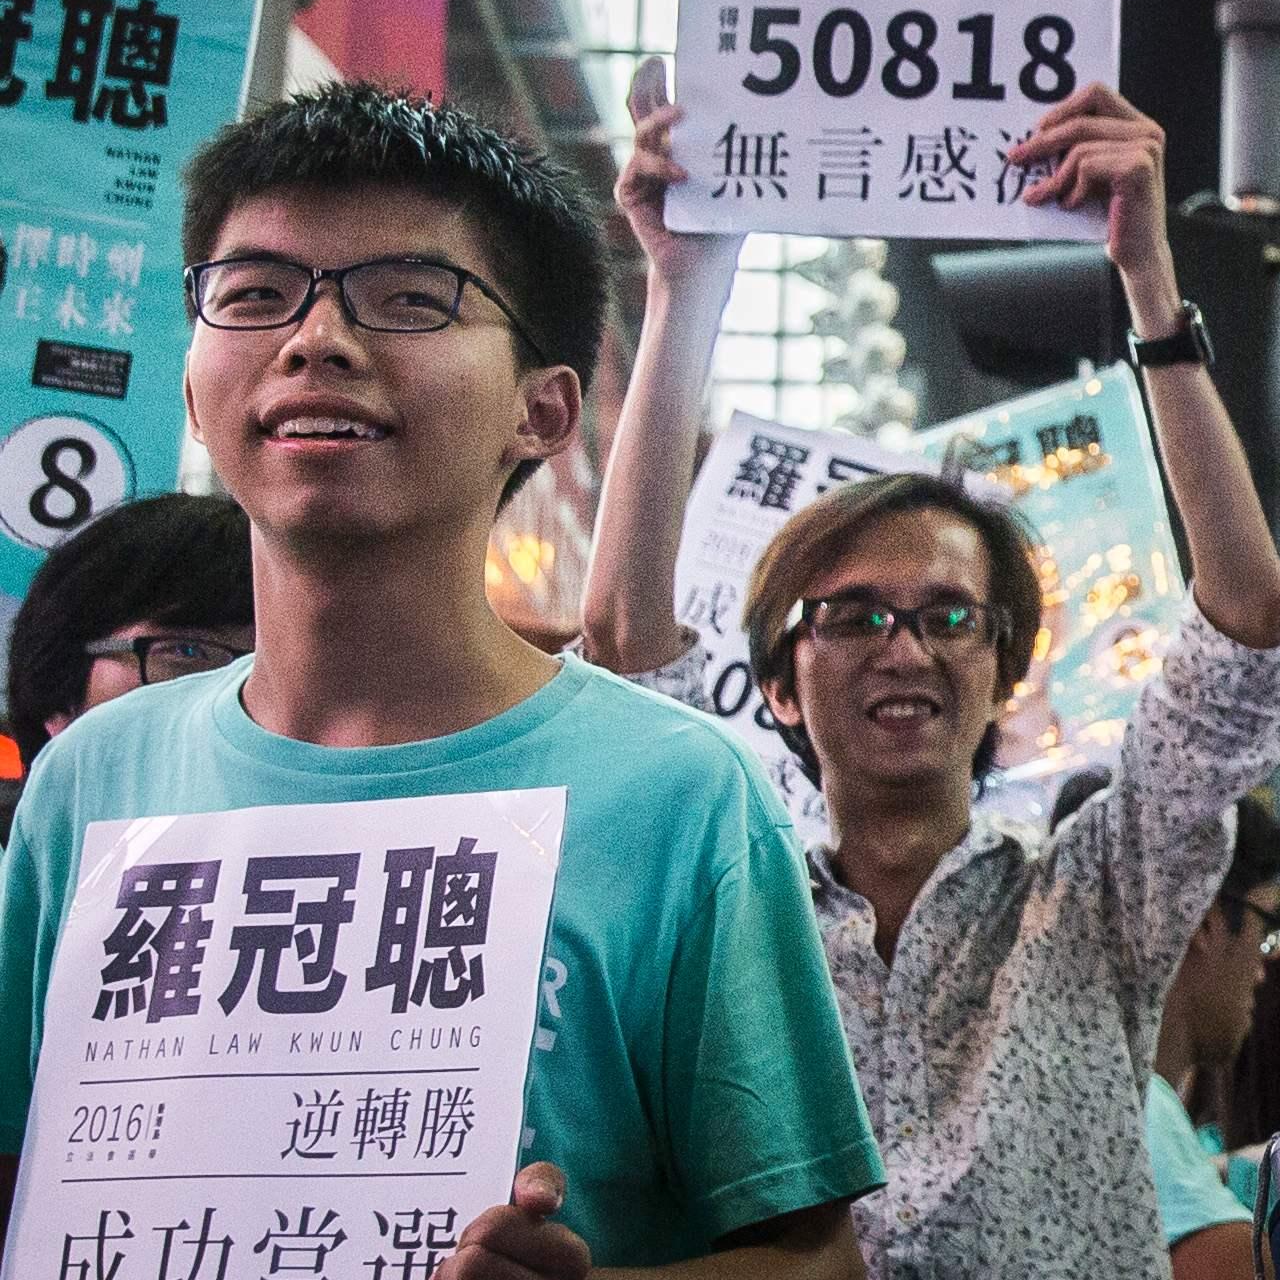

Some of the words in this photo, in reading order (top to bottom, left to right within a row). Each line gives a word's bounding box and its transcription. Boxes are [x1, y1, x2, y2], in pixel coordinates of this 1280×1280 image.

[741, 7, 1077, 104] 50818
[29, 436, 97, 528] 8
[91, 836, 499, 1024] 羅冠聰
[84, 1035, 186, 1063] NATHAN
[208, 1031, 263, 1056] LAW
[288, 1029, 364, 1054] KWUN
[390, 1025, 484, 1052] CHUNG
[68, 1103, 145, 1144] 2016
[279, 1085, 476, 1162] 逆轉勝
